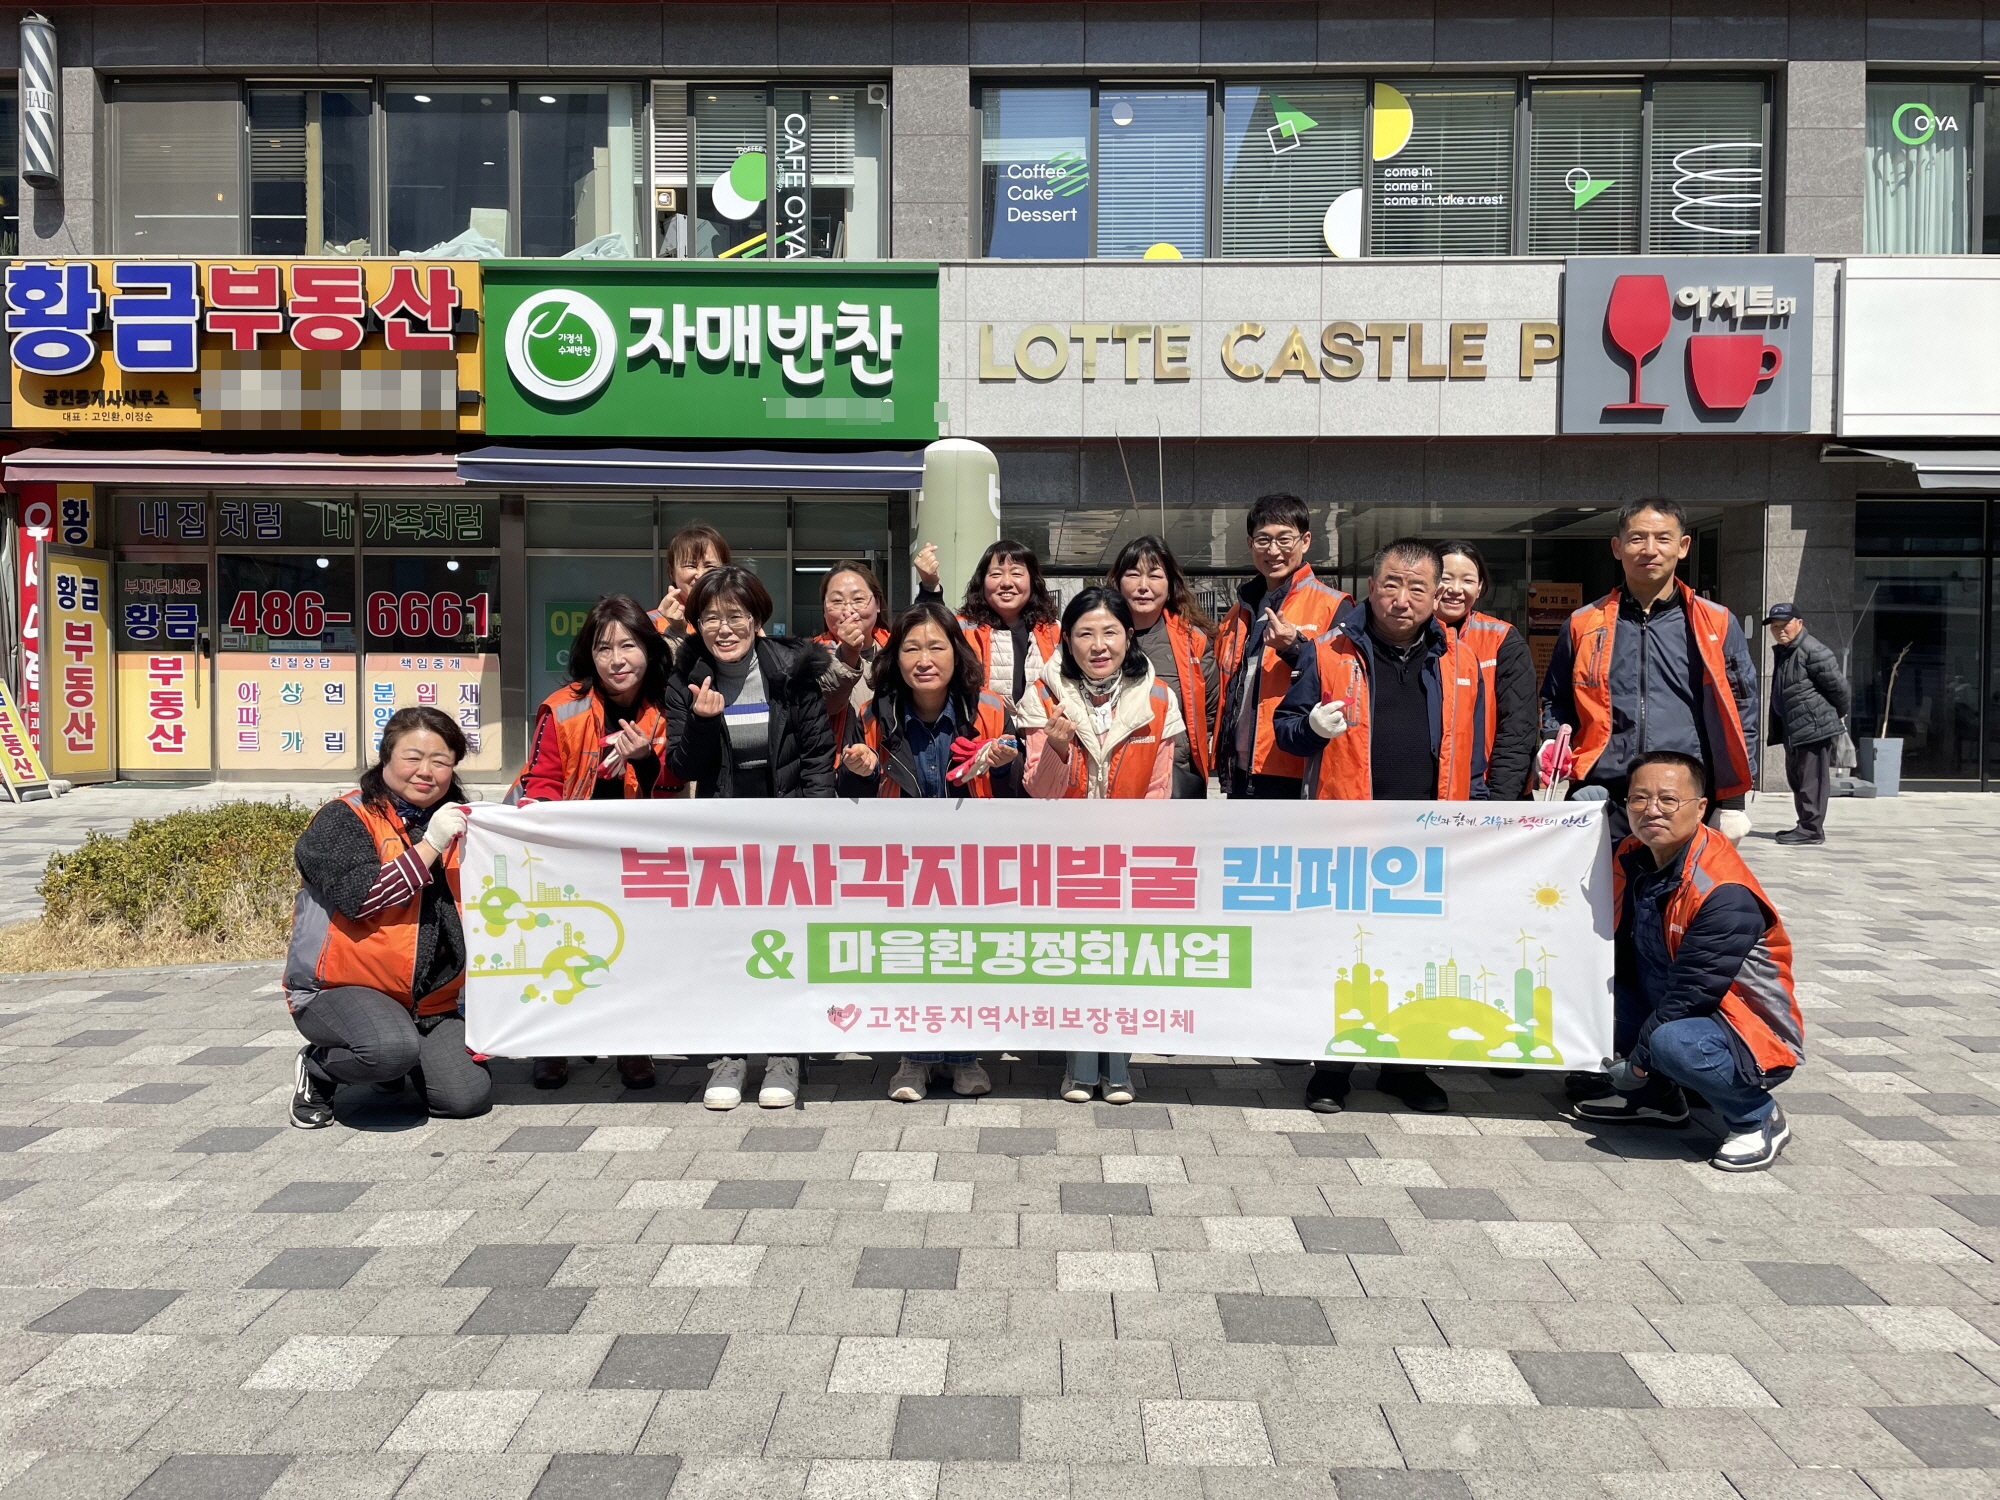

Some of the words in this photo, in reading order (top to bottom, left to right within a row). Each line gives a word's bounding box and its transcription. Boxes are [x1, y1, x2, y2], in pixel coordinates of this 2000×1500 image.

[1914, 115, 1958, 132] O:YA
[784, 113, 806, 188] CAFE
[1007, 164, 1067, 179] Coffee
[1384, 168, 1419, 177] come
[1421, 165, 1433, 177] in
[1007, 185, 1054, 200] Cake
[1384, 182, 1418, 191] come
[1421, 180, 1433, 191] in
[1384, 197, 1418, 205] come
[1421, 194, 1435, 206] in,
[1438, 194, 1464, 205] take
[1468, 196, 1476, 205] a
[1478, 194, 1504, 205] rest
[1007, 207, 1078, 222] Dessert
[1676, 285, 1775, 318] 아지트
[1776, 296, 1797, 315] B1
[558, 333, 583, 344] 가정식
[626, 301, 903, 386] 자매반찬
[558, 345, 592, 356] 수제반찬
[979, 323, 1191, 380] LOTTE
[1221, 321, 1488, 380] CASTLE
[62, 411, 81, 422] 대표
[56, 573, 100, 613] 황금
[124, 578, 202, 595] 부자되세요
[124, 603, 199, 641] 황금
[61, 620, 97, 754] 부동산
[147, 656, 187, 754] 부동산
[1416, 810, 1450, 830] 시민과
[1480, 815, 1514, 831] 자유로운
[1518, 815, 1557, 831] 혁신도시
[1561, 814, 1593, 828] 안산
[620, 843, 1199, 910] 복지사각지대발굴
[1221, 845, 1445, 916] 캠페인
[744, 929, 796, 980] &
[827, 929, 1232, 980] 마을환경정화사업
[866, 1004, 1196, 1036] 고잔동지역사회보장협의체
